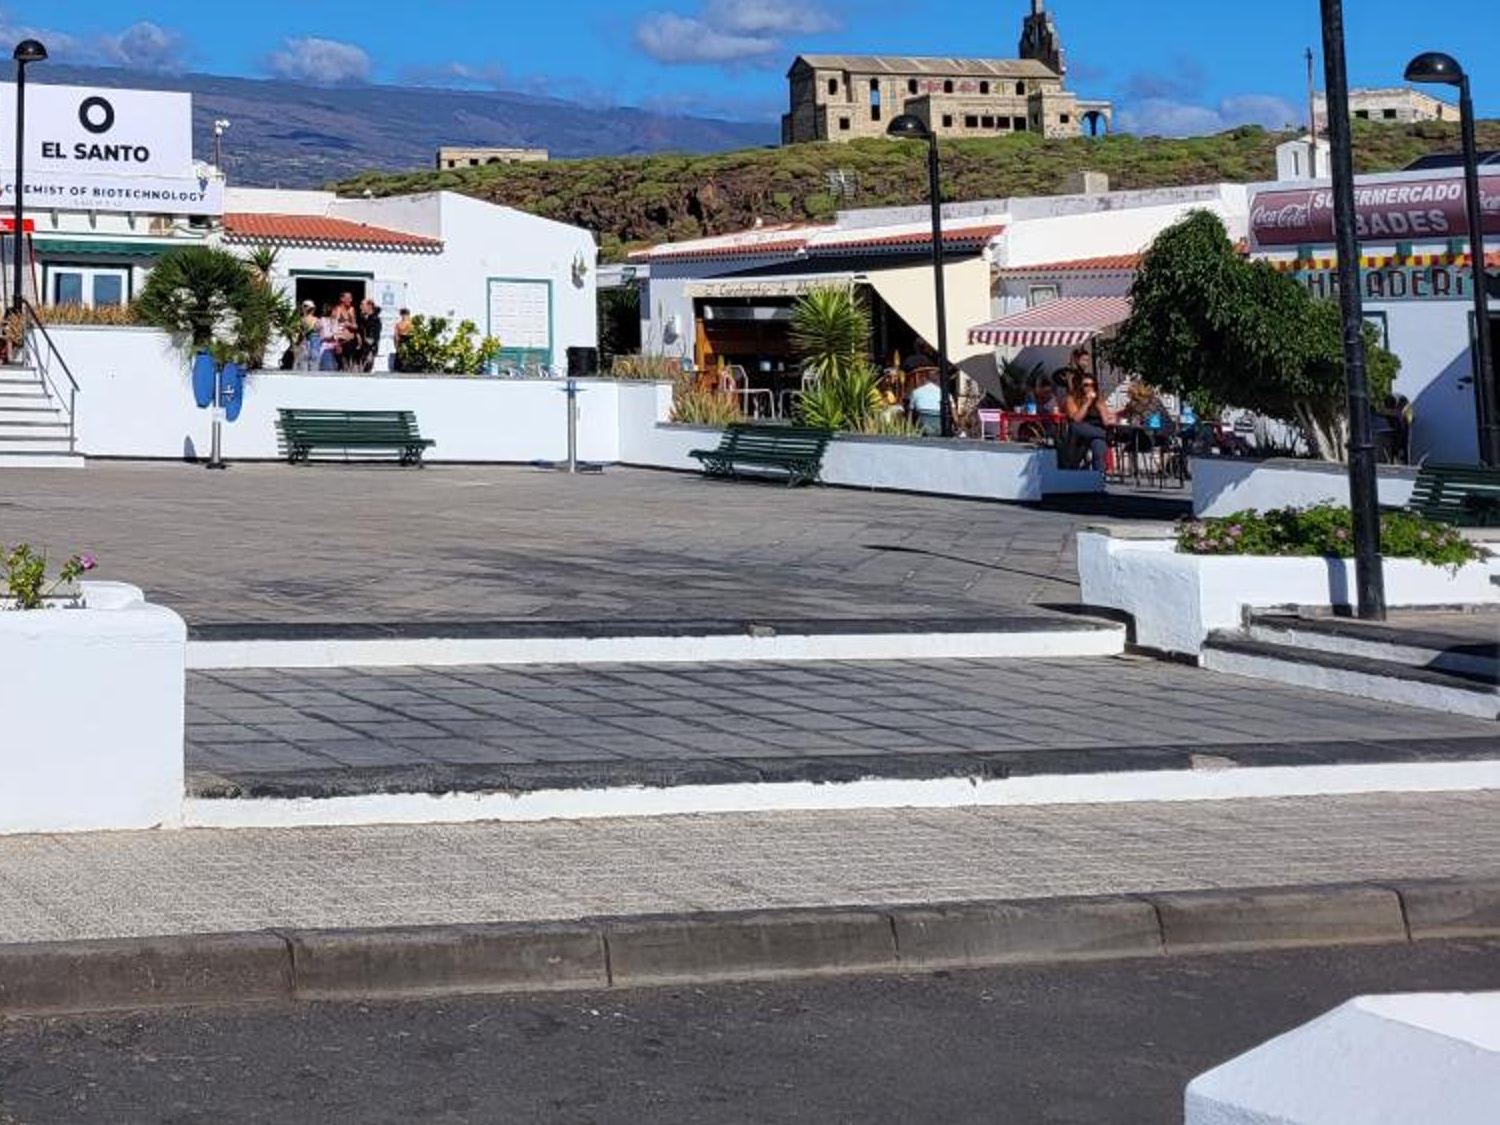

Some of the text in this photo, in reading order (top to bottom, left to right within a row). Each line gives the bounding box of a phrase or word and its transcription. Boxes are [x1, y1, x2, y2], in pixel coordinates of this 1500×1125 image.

[42, 142, 150, 163] EL SANTO
[70, 186, 87, 196] OF
[93, 188, 206, 202] BIOTECHNOLOGY
[1314, 184, 1462, 210] SUERMERCADO
[1332, 208, 1449, 236] BADES
